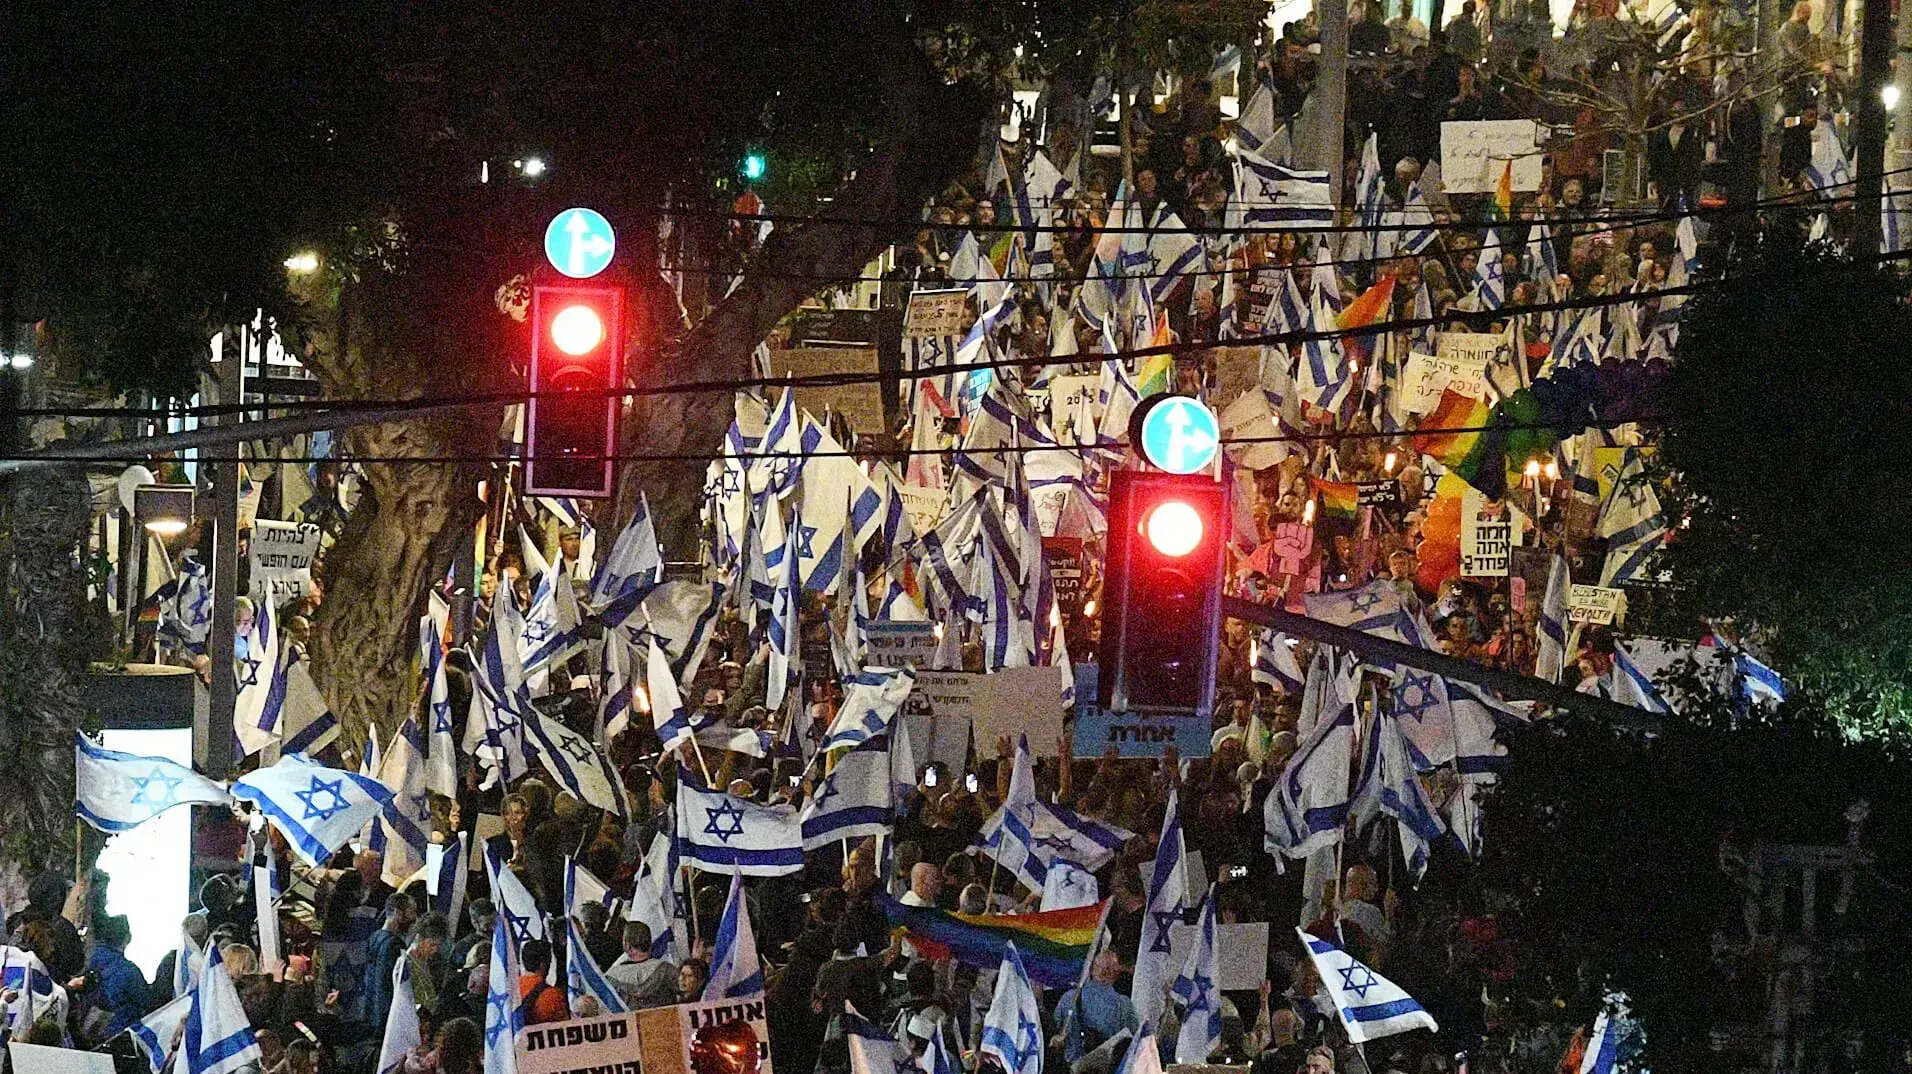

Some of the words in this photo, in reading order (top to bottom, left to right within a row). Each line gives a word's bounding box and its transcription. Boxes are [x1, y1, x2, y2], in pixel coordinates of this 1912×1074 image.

[264, 524, 306, 544] להיות
[1477, 541, 1511, 554] אתה
[257, 553, 288, 568] חופשי
[291, 555, 309, 569] עם
[258, 580, 301, 595] בארצו
[689, 1001, 764, 1029] אנחנו
[527, 1019, 627, 1051] משפחת
